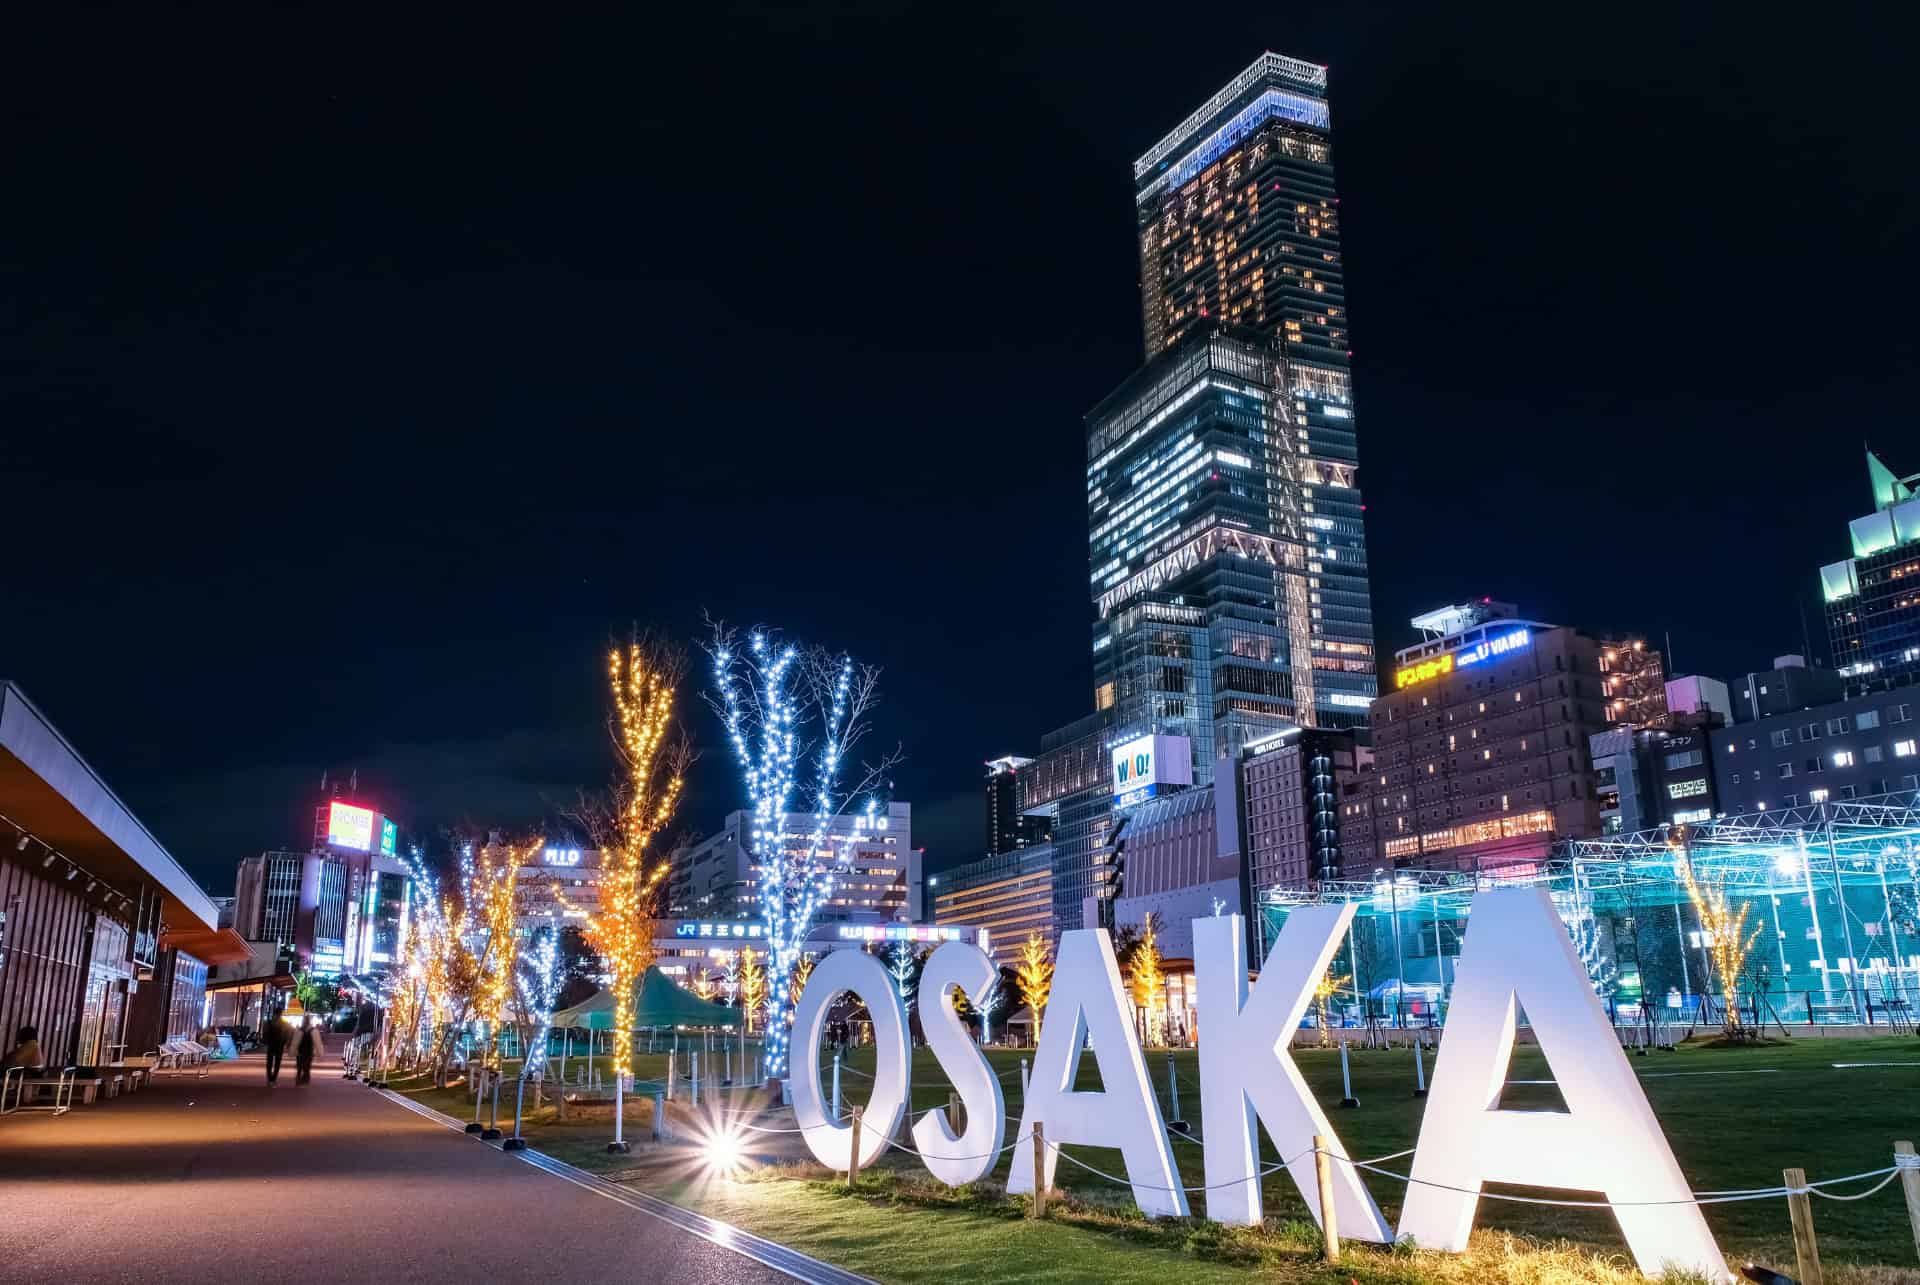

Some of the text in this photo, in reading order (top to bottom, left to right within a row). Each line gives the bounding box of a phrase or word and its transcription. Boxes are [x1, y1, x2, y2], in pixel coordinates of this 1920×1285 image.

[1117, 751, 1150, 783] WAO!
[676, 924, 696, 936] JR
[788, 886, 1735, 1283] OSAKA
